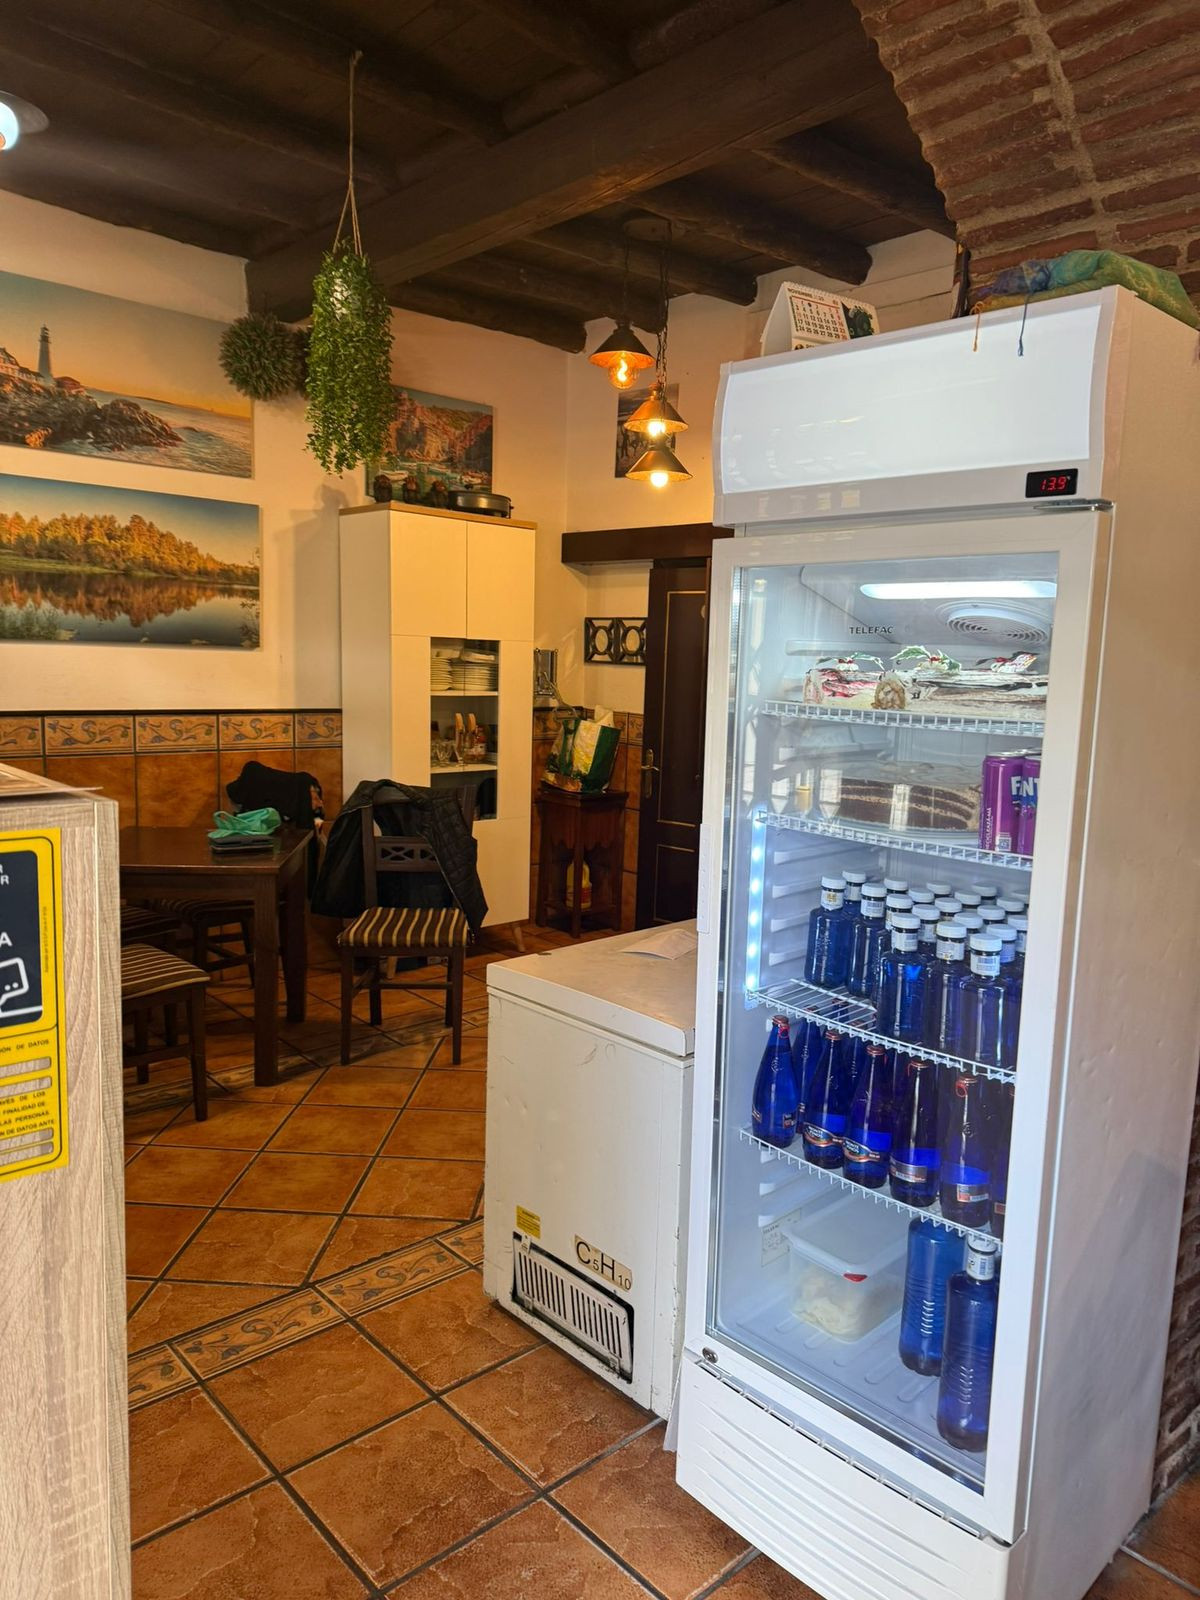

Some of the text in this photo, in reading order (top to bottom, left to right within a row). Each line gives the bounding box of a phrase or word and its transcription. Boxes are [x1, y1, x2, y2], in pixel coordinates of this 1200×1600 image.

[3, 1103, 36, 1115] FINALIDAD
[15, 1110, 50, 1122] PERSONAS
[17, 1123, 37, 1133] DATOS
